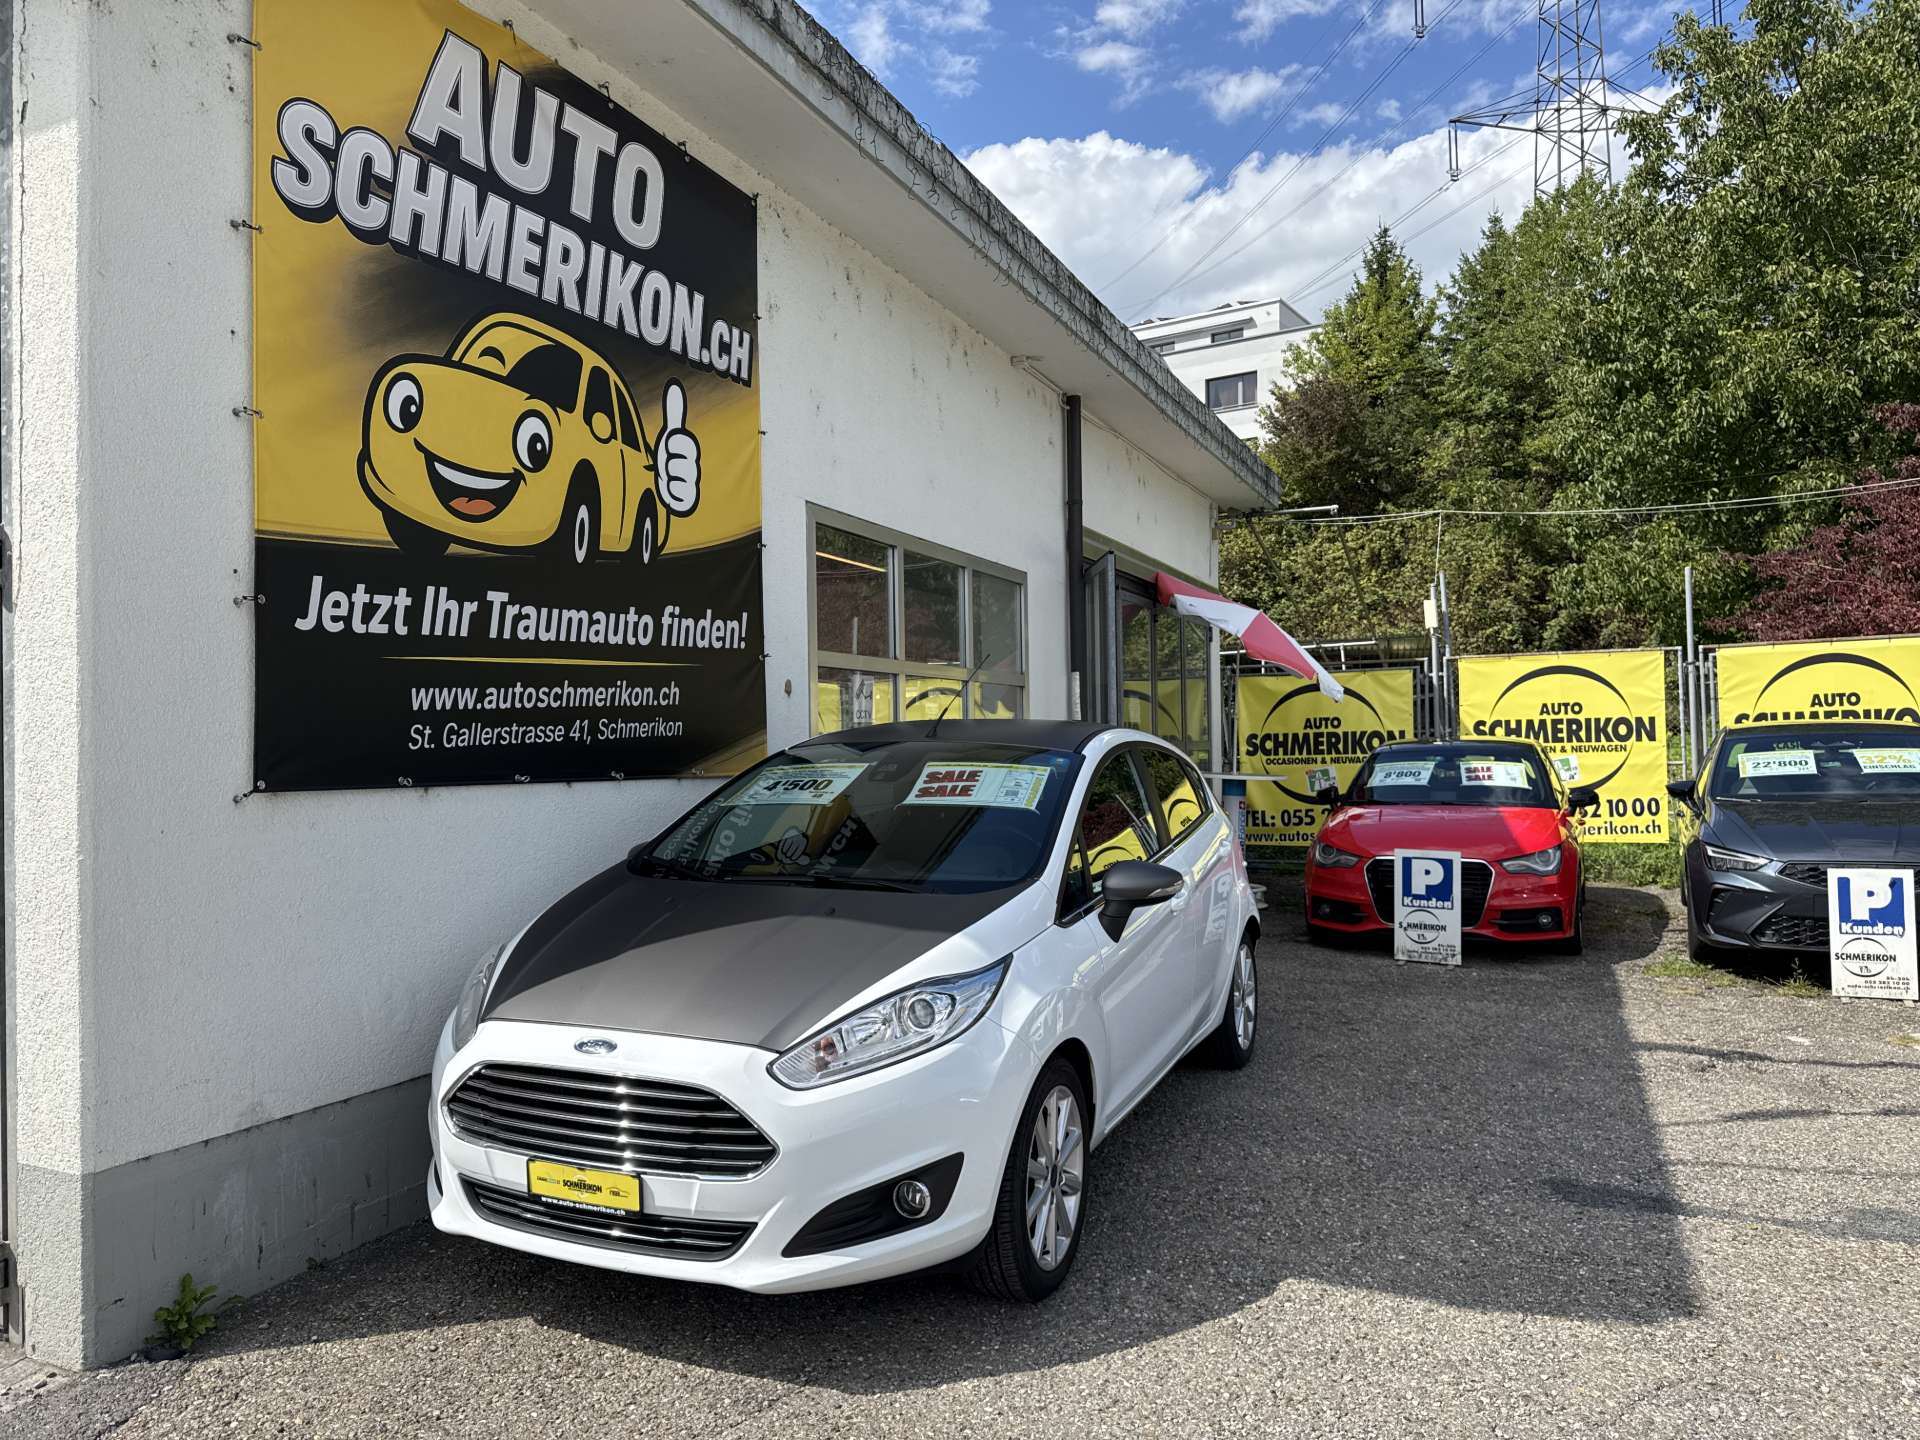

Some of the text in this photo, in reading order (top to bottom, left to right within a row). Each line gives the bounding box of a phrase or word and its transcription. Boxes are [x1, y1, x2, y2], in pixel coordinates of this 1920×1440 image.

[408, 31, 664, 250] AUTO
[273, 101, 751, 381] SCHMERIKON.CH
[294, 575, 748, 649] Jetzt Ihr Traumauto finden!
[411, 680, 680, 711] www.autoschmerikon.ch
[1810, 692, 1861, 708] AUTO
[1539, 702, 1583, 716] AUTO
[1303, 717, 1341, 730] AUTO
[409, 717, 683, 750] St. Gallerstrasse 41, Schmerikon
[1571, 744, 1627, 753] NEUWAGEN
[1265, 757, 1318, 766] OCCASIONEN
[1320, 757, 1327, 765] &
[923, 769, 983, 785] SALE
[1464, 766, 1494, 774] SALE
[763, 779, 834, 791] 4'500
[1464, 774, 1495, 782] SALE
[915, 784, 976, 799] SALE
[1280, 808, 1316, 827] 055
[1403, 896, 1453, 910] Kunden
[1398, 921, 1447, 933] SHMERIKON
[1841, 920, 1904, 935] Kunden
[1834, 952, 1897, 963] SCHMERIKON
[562, 1179, 603, 1194] SCHMERIKON
